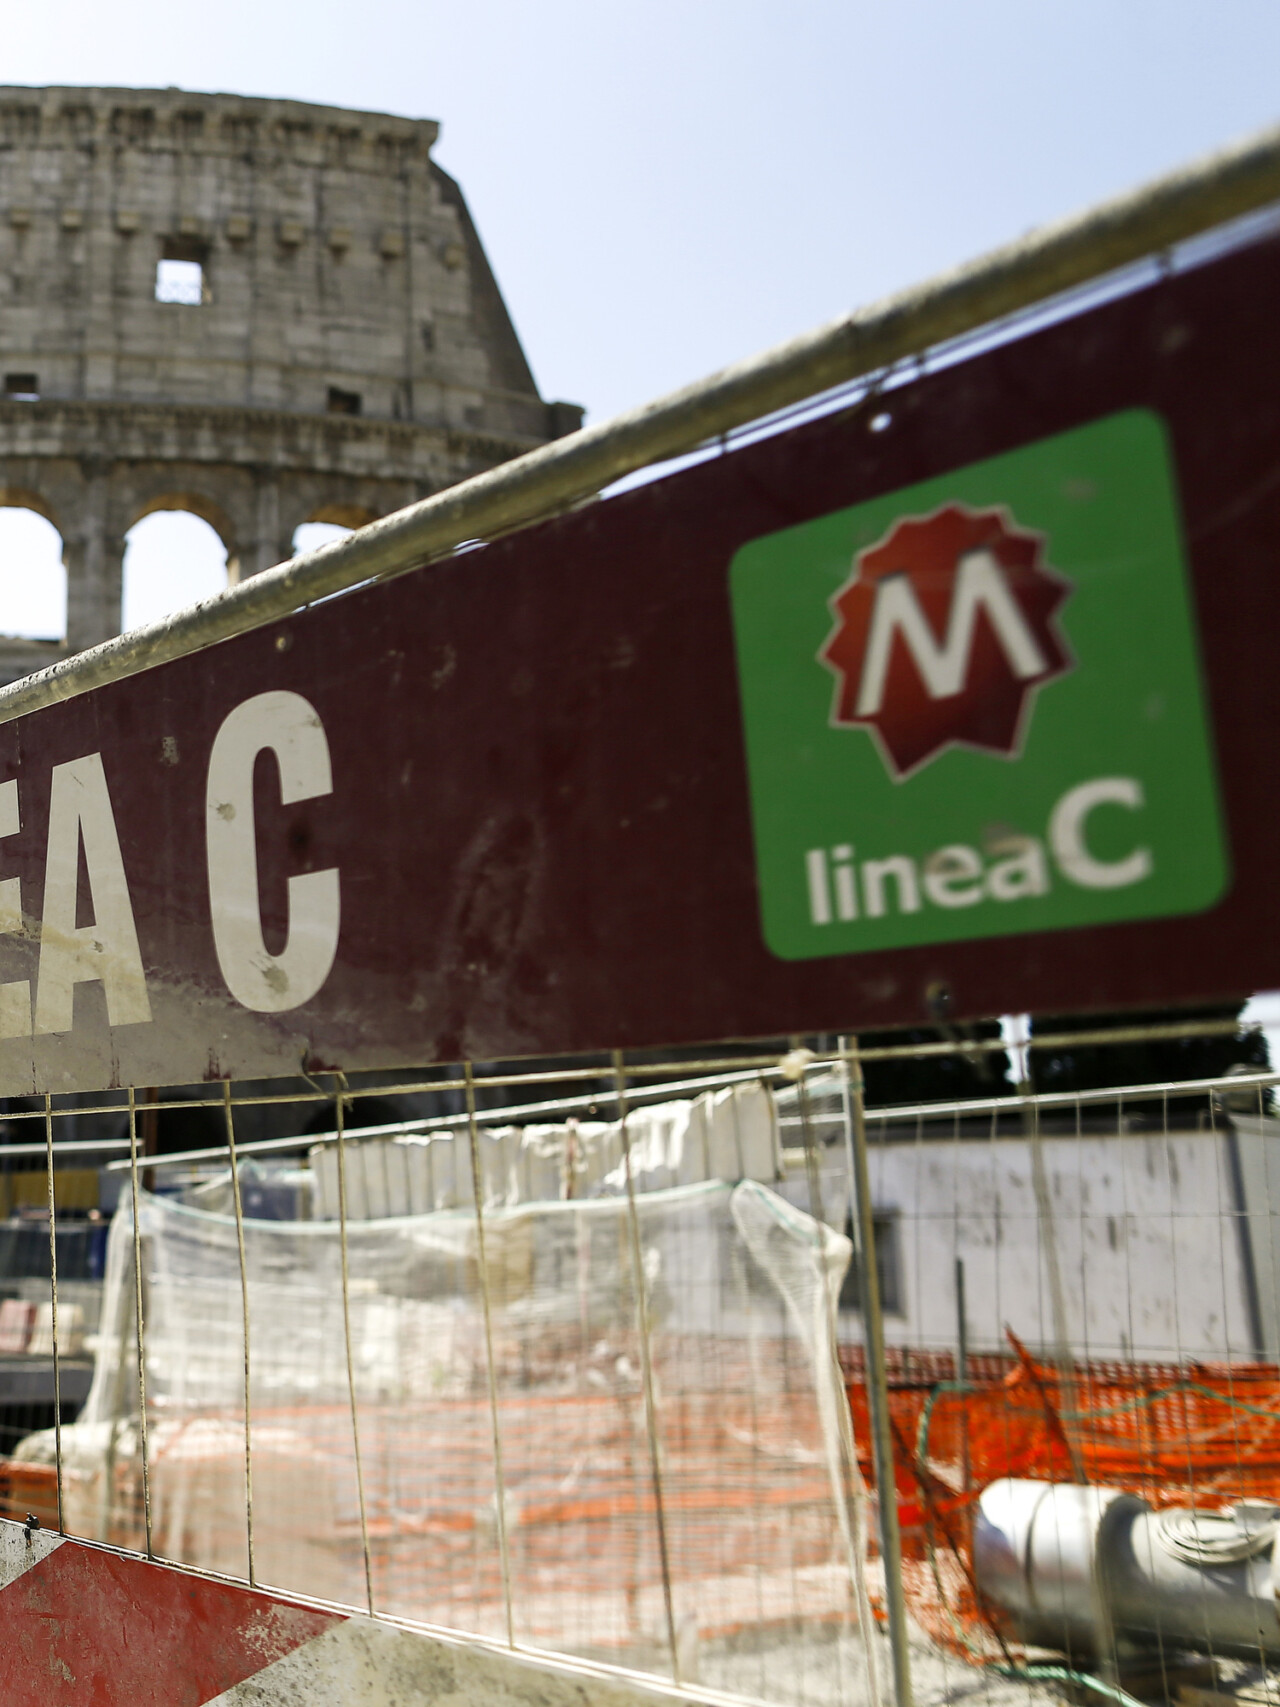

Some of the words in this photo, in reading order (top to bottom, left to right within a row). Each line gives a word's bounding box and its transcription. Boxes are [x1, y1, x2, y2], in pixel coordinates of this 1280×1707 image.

[856, 547, 1047, 717] M
[206, 690, 340, 1013] C
[806, 777, 1152, 926] lineaC
